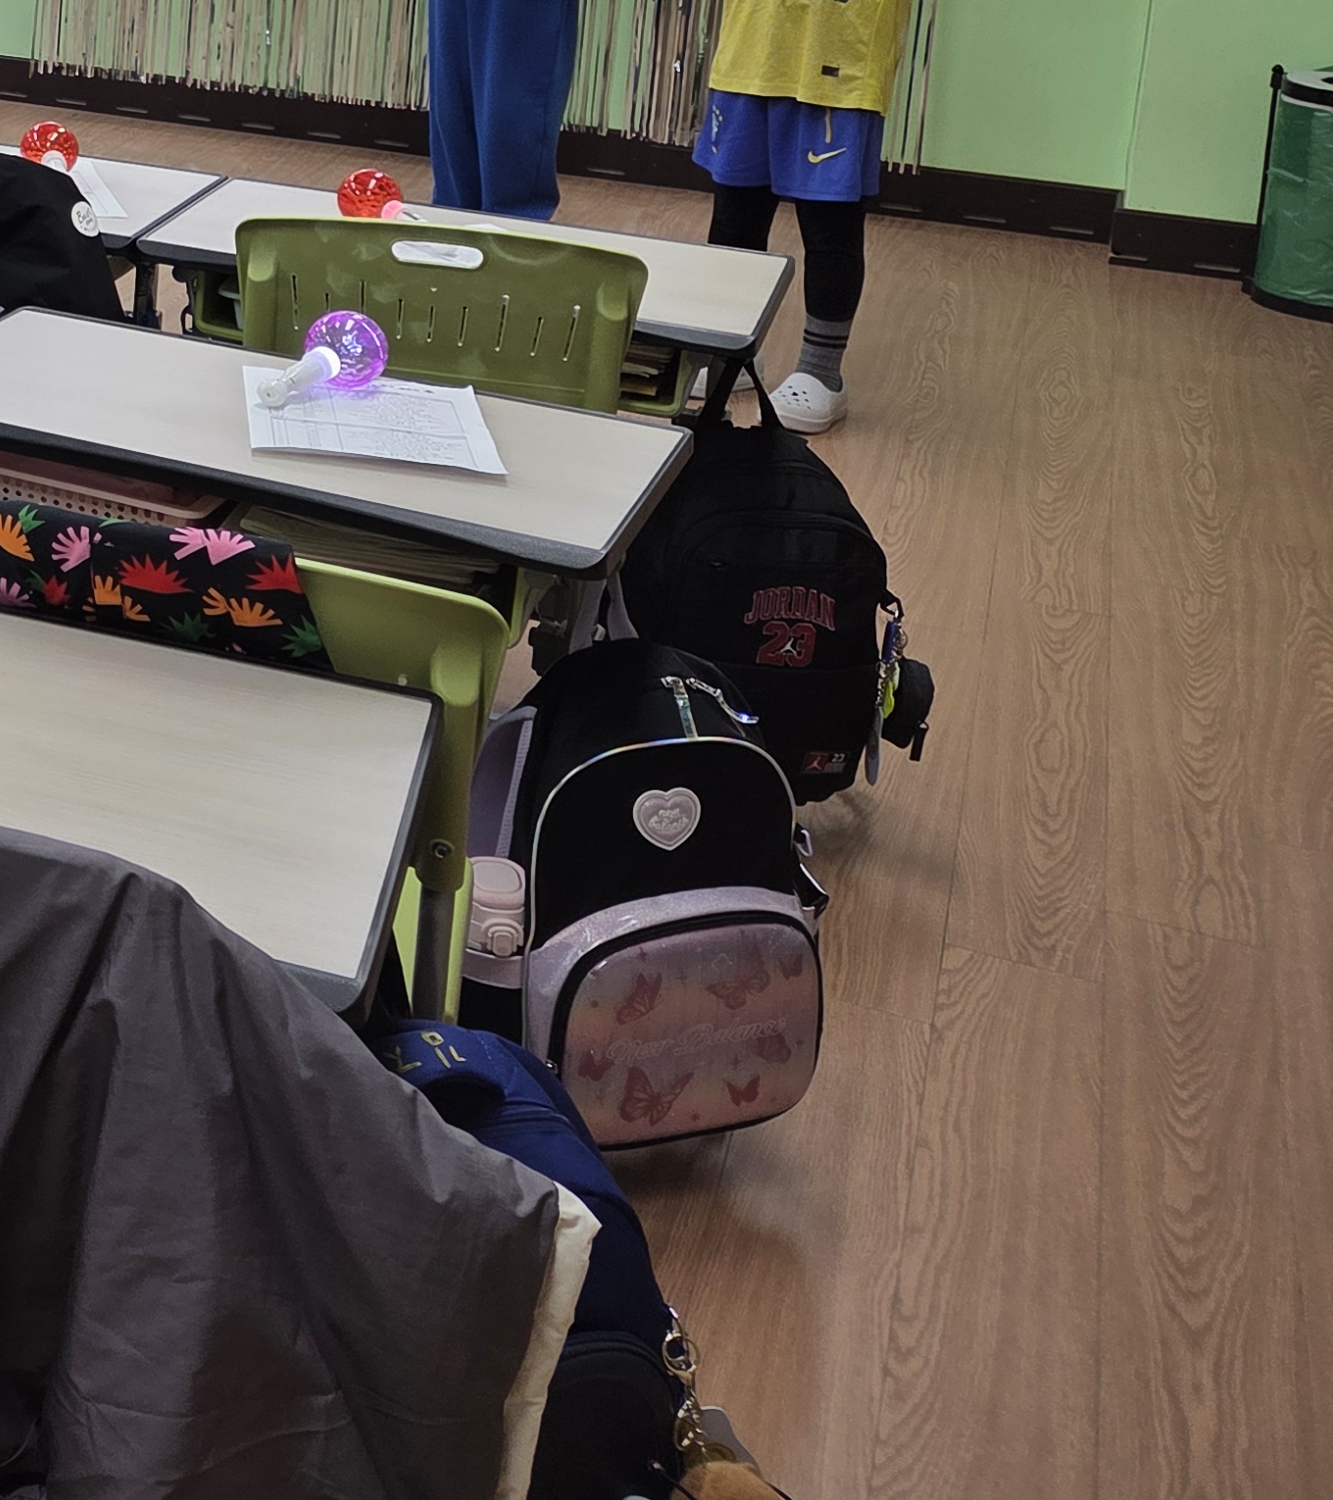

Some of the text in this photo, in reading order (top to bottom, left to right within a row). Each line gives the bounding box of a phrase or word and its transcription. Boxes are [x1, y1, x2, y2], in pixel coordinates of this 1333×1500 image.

[744, 586, 836, 631] JORDAN
[756, 621, 817, 667] 23
[831, 753, 845, 762] 23
[674, 1018, 787, 1056] Balance
